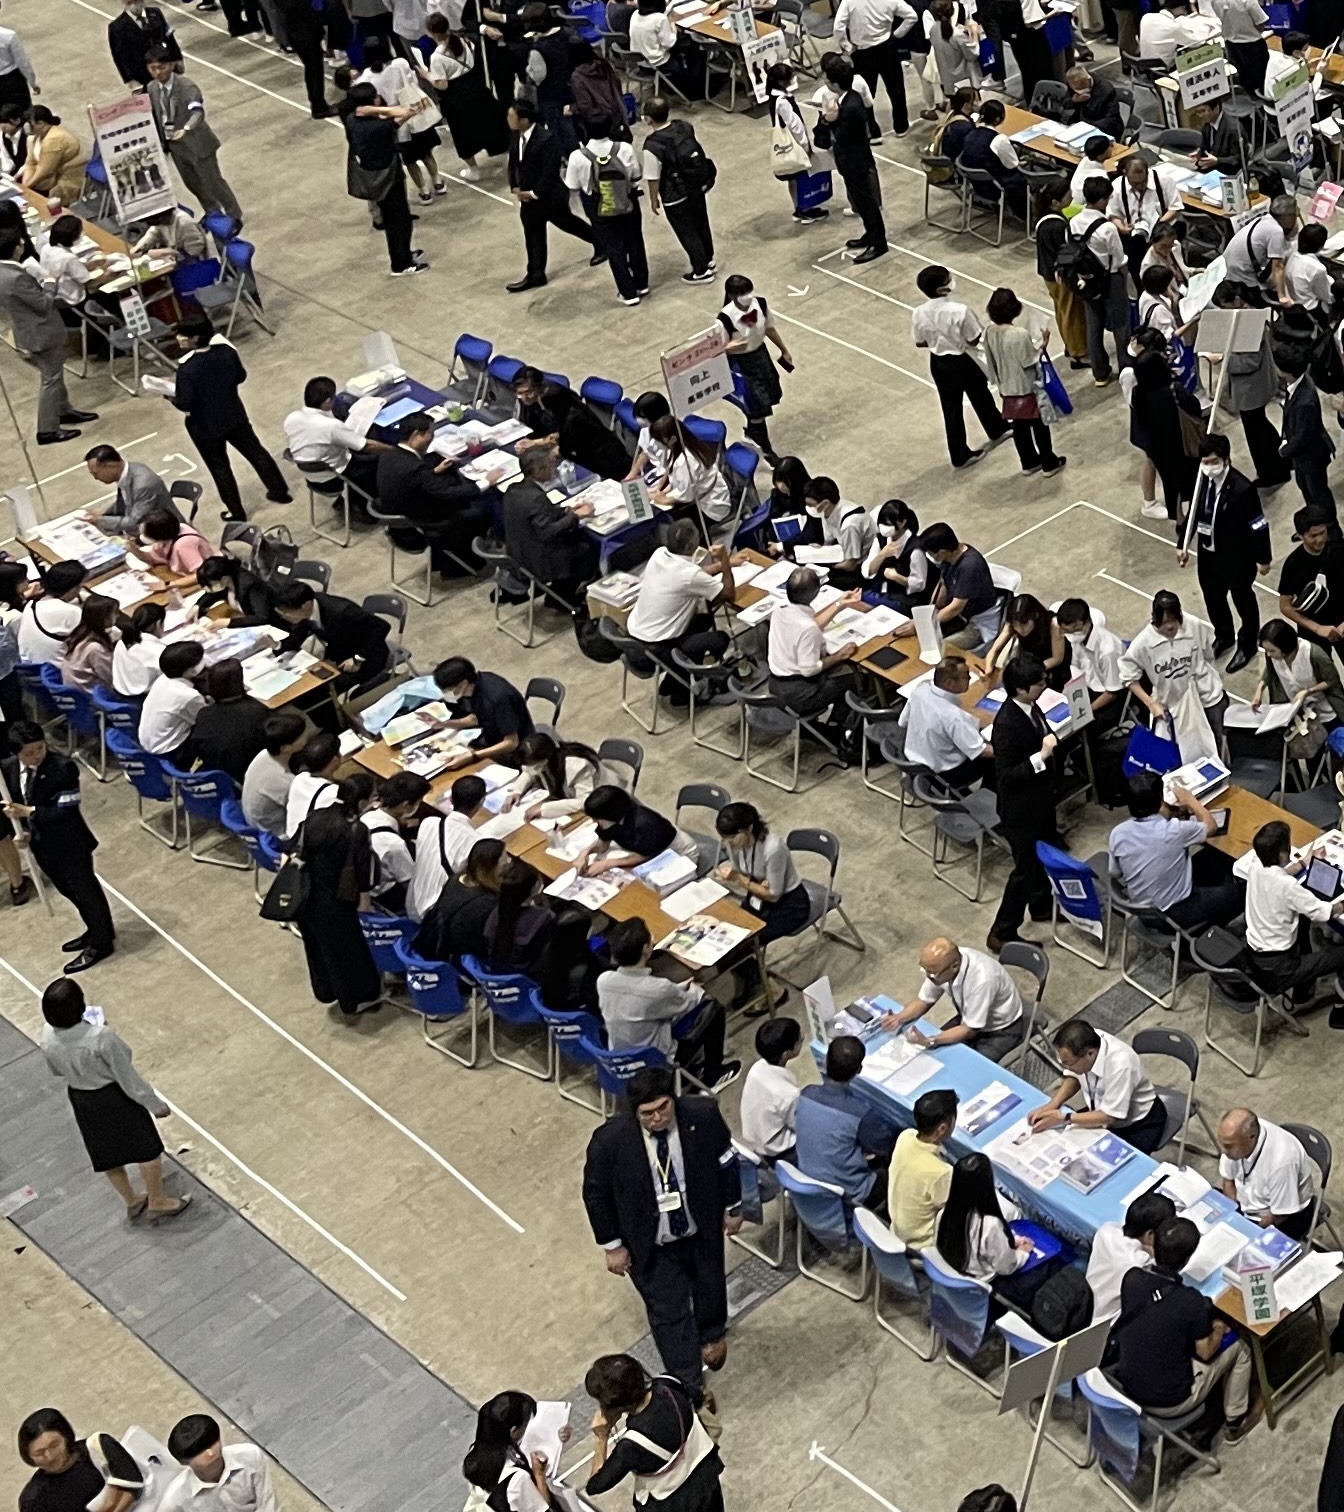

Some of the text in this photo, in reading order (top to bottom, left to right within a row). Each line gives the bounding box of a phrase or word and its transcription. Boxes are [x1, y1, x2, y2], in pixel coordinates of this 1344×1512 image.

[689, 369, 711, 386] 向上
[687, 381, 721, 405] 高等学校
[1249, 1274, 1271, 1320] 平塚学園
